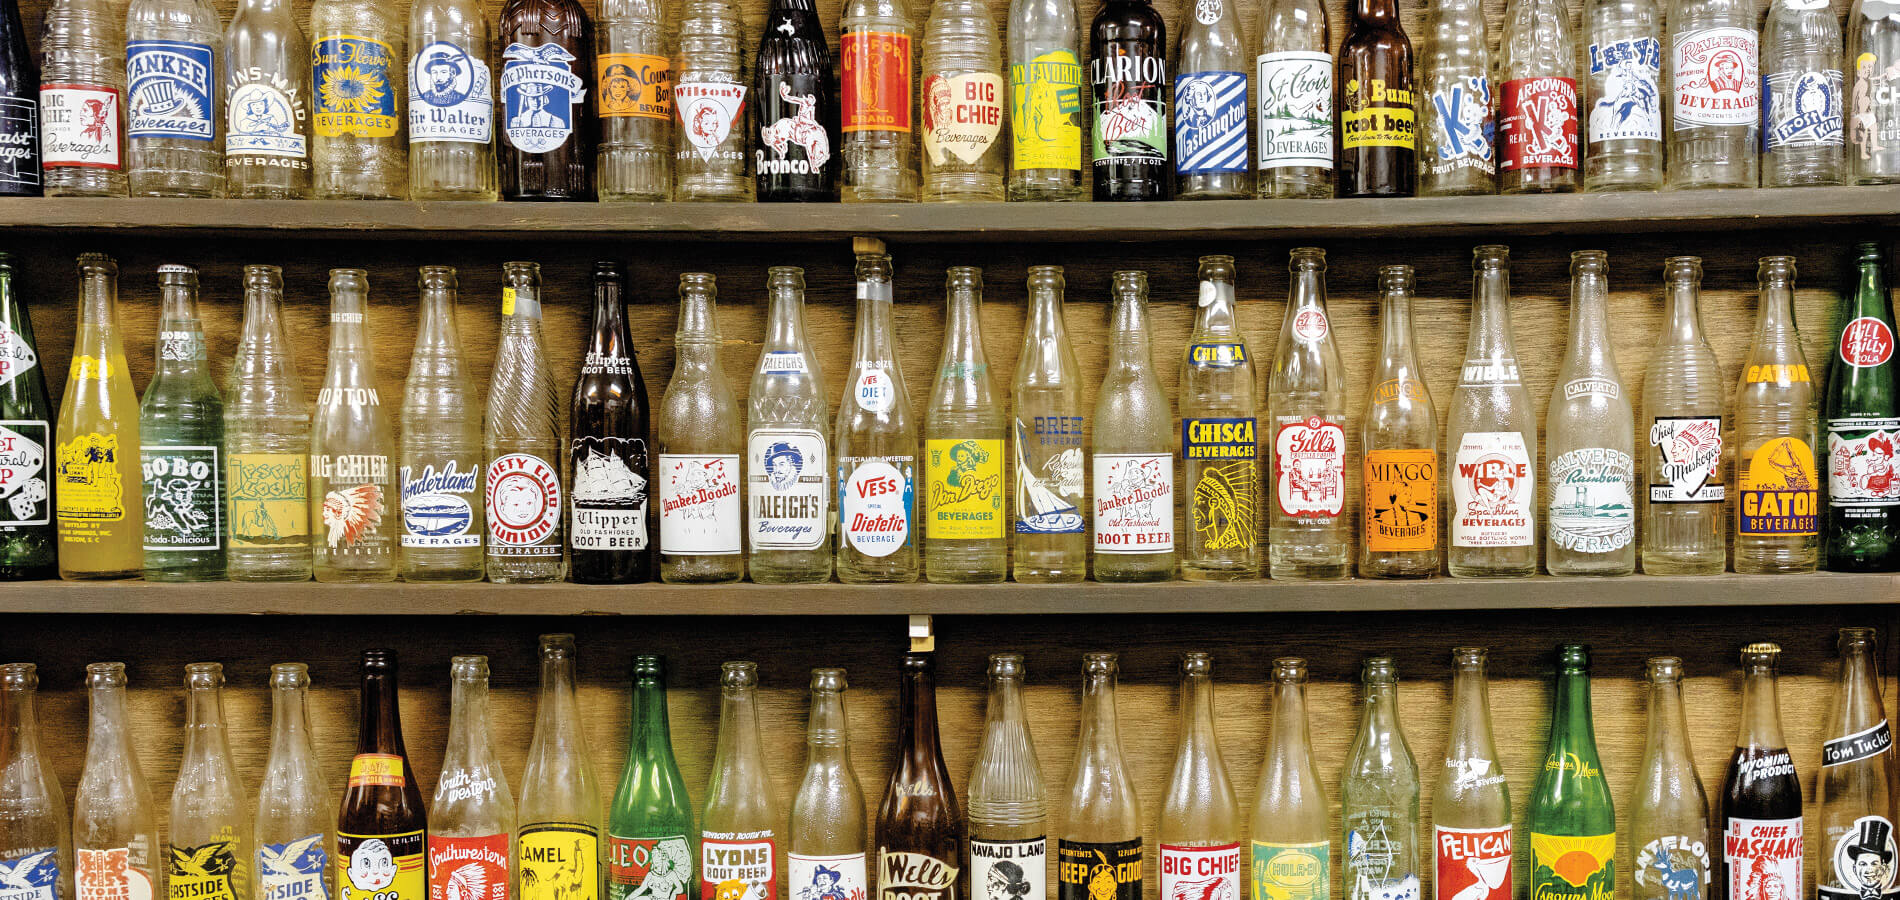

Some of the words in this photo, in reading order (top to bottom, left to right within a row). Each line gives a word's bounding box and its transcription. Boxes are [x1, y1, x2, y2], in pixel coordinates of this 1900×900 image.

[127, 54, 207, 86] YANKEE
[1013, 64, 1025, 83] MY
[1091, 56, 1165, 86] CLARION
[1290, 64, 1331, 98] Croix
[46, 95, 64, 107] BIG
[676, 87, 741, 99] Wilson's
[966, 82, 994, 102] BIG
[1105, 80, 1155, 113] Root
[129, 109, 207, 132] Beverages
[316, 115, 391, 128] BEVERAGES
[410, 109, 425, 124] Sir
[430, 108, 485, 126] Walter
[850, 115, 895, 124] BRAND
[956, 105, 1000, 126] CHIEF
[1346, 114, 1378, 133] root
[1384, 113, 1414, 133] beer
[511, 129, 565, 138] BEVERAGES
[936, 129, 988, 149] Beverages
[1106, 113, 1147, 146] Beer
[1176, 101, 1246, 165] Washington
[1510, 133, 1527, 144] REAL
[1267, 129, 1328, 156] BEVERAGES
[677, 151, 743, 160] EVERAGES
[756, 150, 809, 175] Bronco
[1432, 162, 1456, 175] FRUIT
[342, 313, 362, 323] CHIEF
[585, 352, 631, 367] Clipper
[1193, 345, 1245, 362] CHISCA
[1854, 354, 1879, 363] COLA
[581, 366, 603, 375] ROOT
[607, 366, 633, 375] BEER
[1464, 365, 1520, 382] WIBLE
[1746, 364, 1810, 383] GATOR
[862, 387, 886, 397] DIET
[1379, 384, 1424, 399] MINGO
[1188, 420, 1255, 444] CHISCA
[1651, 421, 1675, 445] Chief
[1189, 445, 1255, 458] BEVERAGES
[311, 455, 330, 477] BIG
[337, 454, 388, 478] CHIEF
[1371, 463, 1433, 482] MINGO
[1459, 463, 1527, 478] WIBLE
[1566, 465, 1622, 484] Rainbow
[857, 476, 897, 499] VESS
[930, 480, 956, 512] Don
[957, 474, 1000, 502] Diego
[1655, 490, 1674, 498] FINE
[663, 492, 698, 517] Yankee
[699, 482, 737, 502] Doodle
[1097, 494, 1133, 517] Yankee
[1134, 481, 1171, 503] Doodle
[1744, 492, 1817, 517] GATOR
[937, 511, 994, 521] BEVERAGES
[1468, 500, 1519, 519] Spakling
[577, 510, 638, 530] Clipper
[851, 513, 905, 532] Dietetic
[1108, 518, 1120, 527] Old
[1121, 516, 1161, 527] Fashioned
[1462, 518, 1527, 527] BEVERAGES
[1751, 518, 1815, 530] BEVERAGES
[150, 535, 210, 545] Soda-Delicious
[490, 520, 551, 543] JUNIOR
[758, 521, 813, 540] Beverages
[857, 535, 896, 543] BEVERAGE
[1097, 533, 1132, 545] ROOT
[1136, 532, 1171, 545] BEER
[1379, 524, 1426, 537] BEVERAGES
[575, 536, 602, 546] ROOT
[616, 536, 641, 547] BEER
[1825, 743, 1854, 762] Tom
[1855, 730, 1891, 752] Tucker
[1737, 753, 1744, 765] A
[1740, 753, 1790, 775] WYOMING
[1753, 764, 1795, 781] PRODUCT
[435, 768, 470, 801] South
[1751, 825, 1788, 838] CHIEF
[972, 844, 1012, 858] NAVAJO
[1019, 843, 1044, 857] LAND
[1441, 831, 1511, 860] PELICAN
[430, 844, 507, 879] Southwestern
[608, 844, 649, 868] LEO
[706, 848, 767, 866] LYONS
[1163, 855, 1192, 876] BIG
[1198, 853, 1239, 876] CHIEF
[707, 869, 733, 880] ROOT
[739, 867, 767, 880] BEER
[887, 855, 952, 886] Wells
[81, 886, 129, 896] LYONS
[171, 879, 223, 899] EASTSIDE
